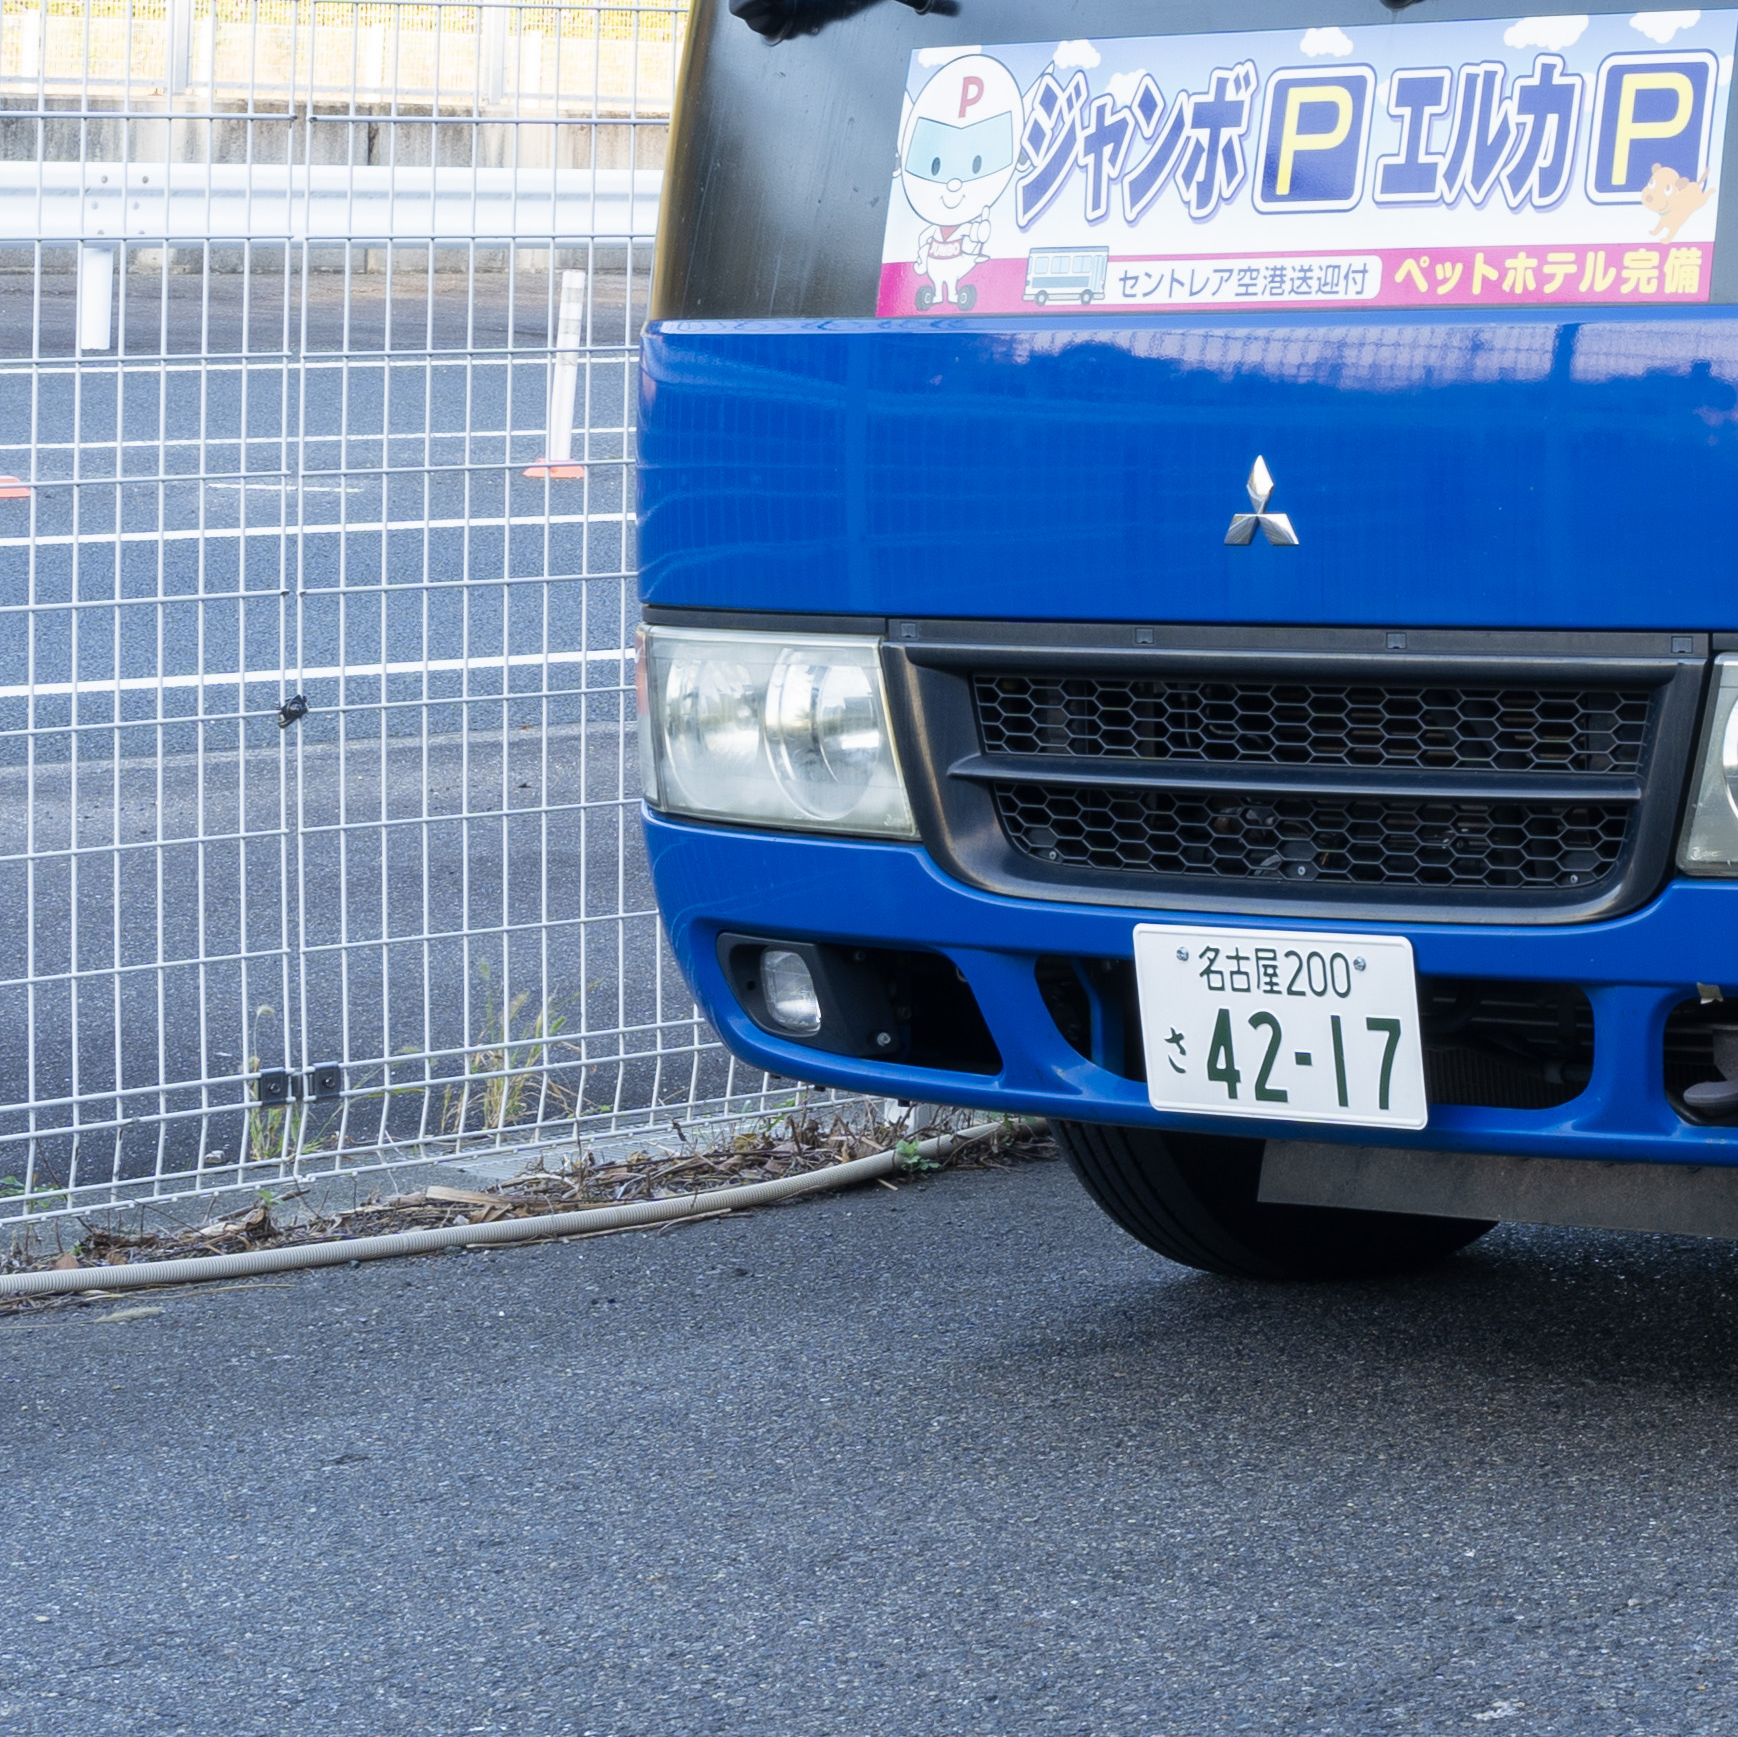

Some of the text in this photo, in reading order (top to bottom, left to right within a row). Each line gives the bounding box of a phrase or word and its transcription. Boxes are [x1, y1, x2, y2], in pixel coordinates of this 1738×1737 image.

[958, 76, 985, 119] P
[929, 240, 961, 257] JUO
[1117, 246, 1703, 300] セントレア空港送迎付 ペットホテル完備
[1198, 945, 1351, 999] 名古屋200
[1164, 1008, 1401, 1110] さ 42-17
